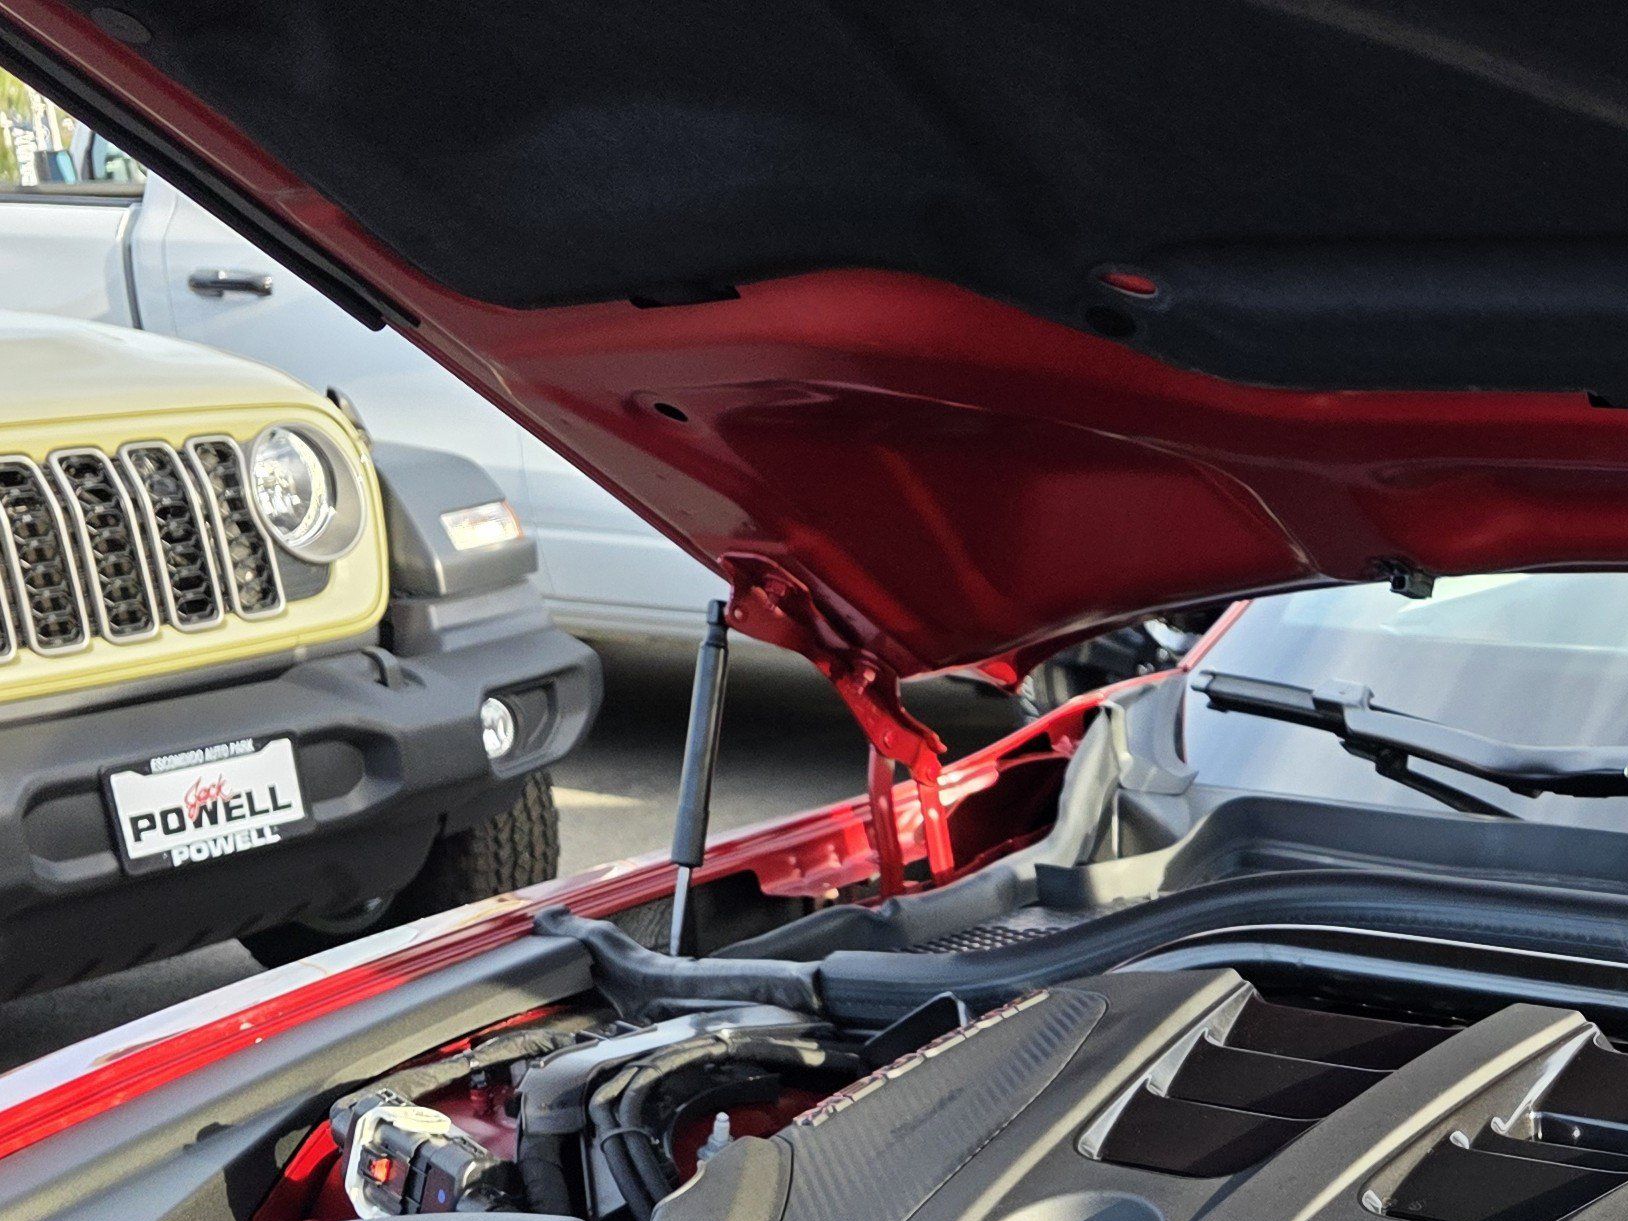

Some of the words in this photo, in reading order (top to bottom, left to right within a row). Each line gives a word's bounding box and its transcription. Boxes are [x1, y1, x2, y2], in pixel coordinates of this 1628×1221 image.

[205, 743, 229, 761] AUTO
[229, 738, 255, 757] PARK
[129, 786, 292, 842] POWELL
[171, 825, 282, 867] POWELL
